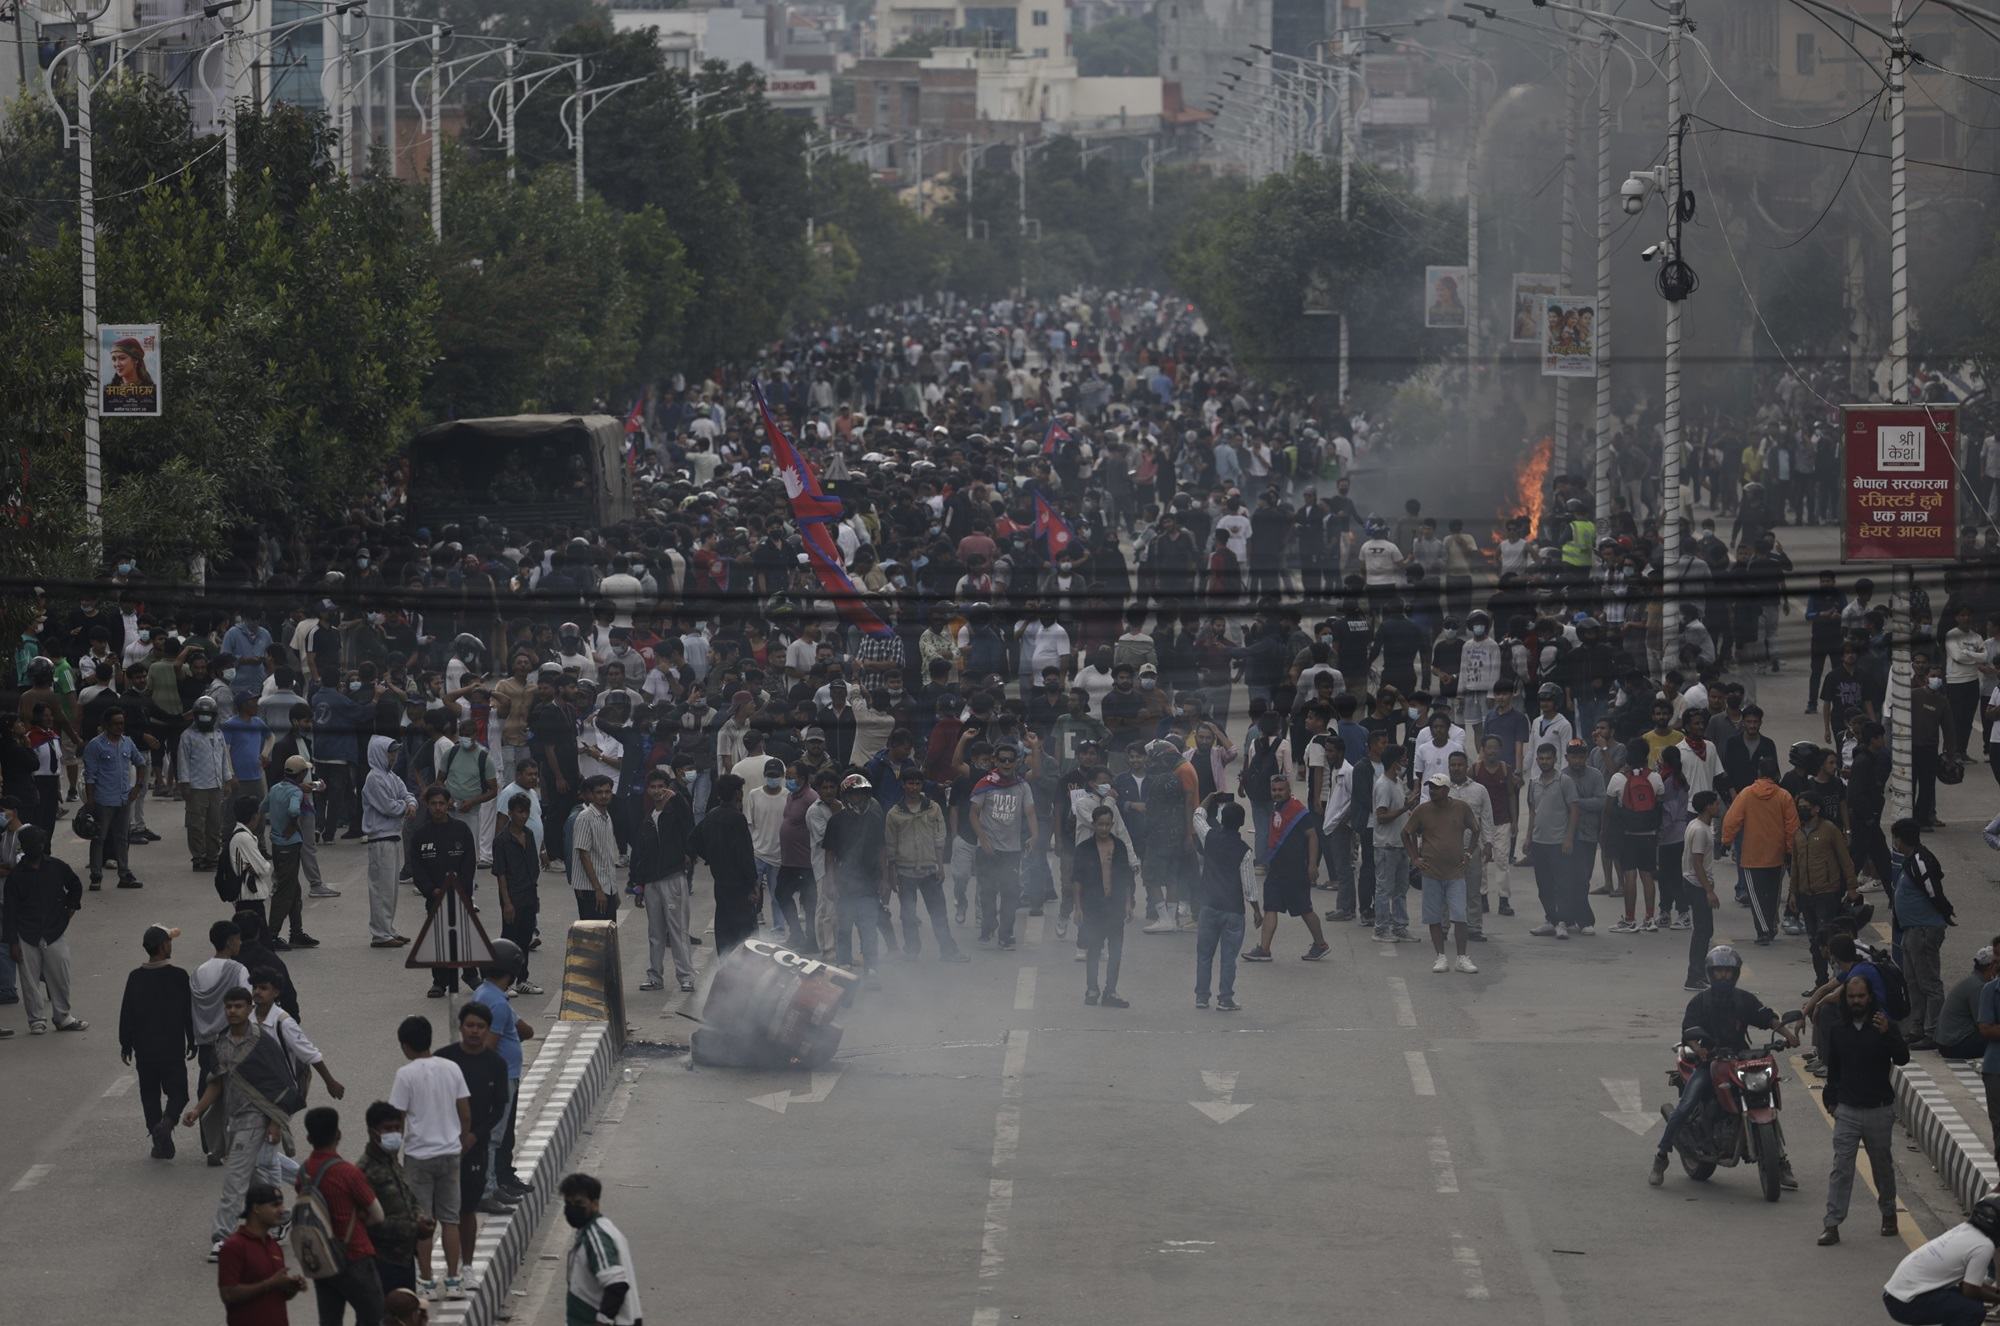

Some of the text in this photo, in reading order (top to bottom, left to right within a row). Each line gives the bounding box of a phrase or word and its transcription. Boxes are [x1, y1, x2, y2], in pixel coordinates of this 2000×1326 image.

[1899, 430, 1915, 446] श्री
[1888, 445, 1915, 460] केश
[1852, 476, 1949, 490] नेपाल सरकारमा
[1859, 491, 1943, 510] रजिस्टर्ड हुने
[1873, 511, 1929, 523] एक मात्र
[1859, 522, 1942, 538] हेयर आयल
